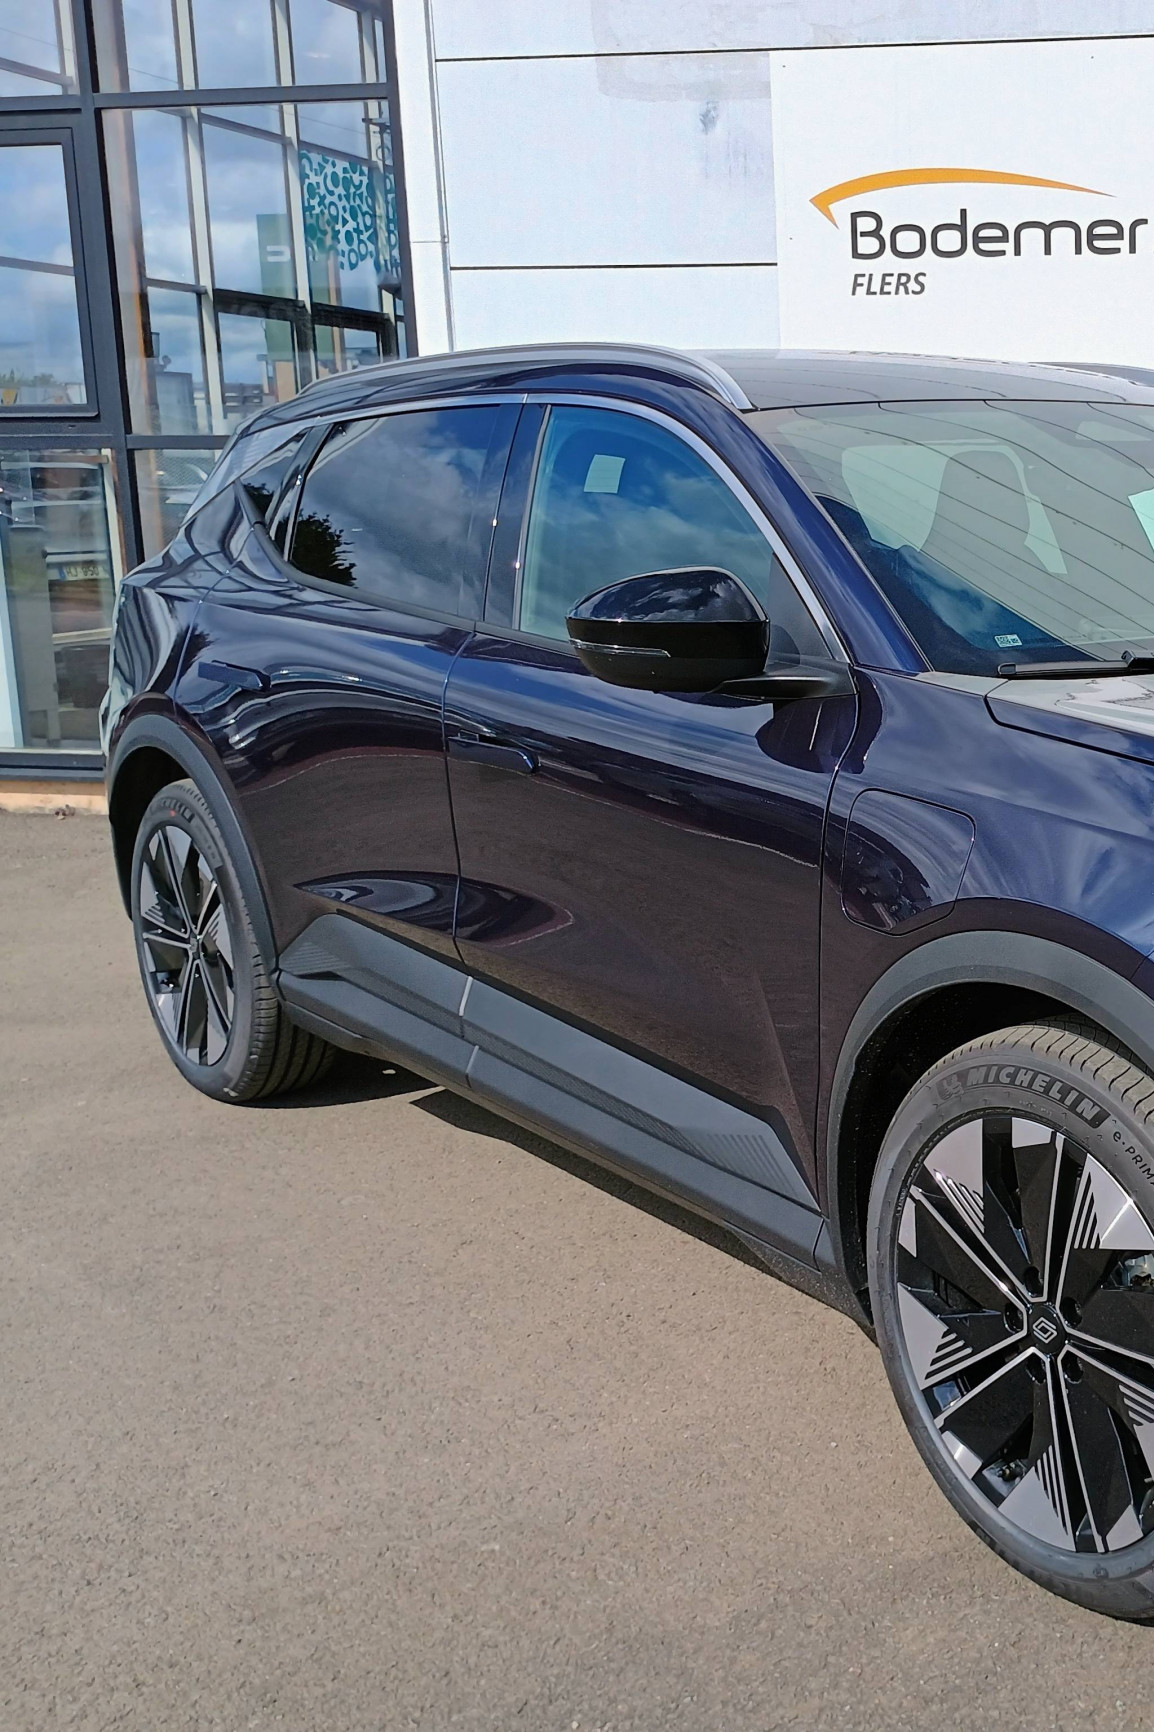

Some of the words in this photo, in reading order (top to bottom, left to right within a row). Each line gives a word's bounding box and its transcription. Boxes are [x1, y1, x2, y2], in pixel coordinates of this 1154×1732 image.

[850, 209, 1149, 260] Bodemer
[851, 272, 927, 296] FLERS
[967, 1066, 1102, 1121] MICHELIN
